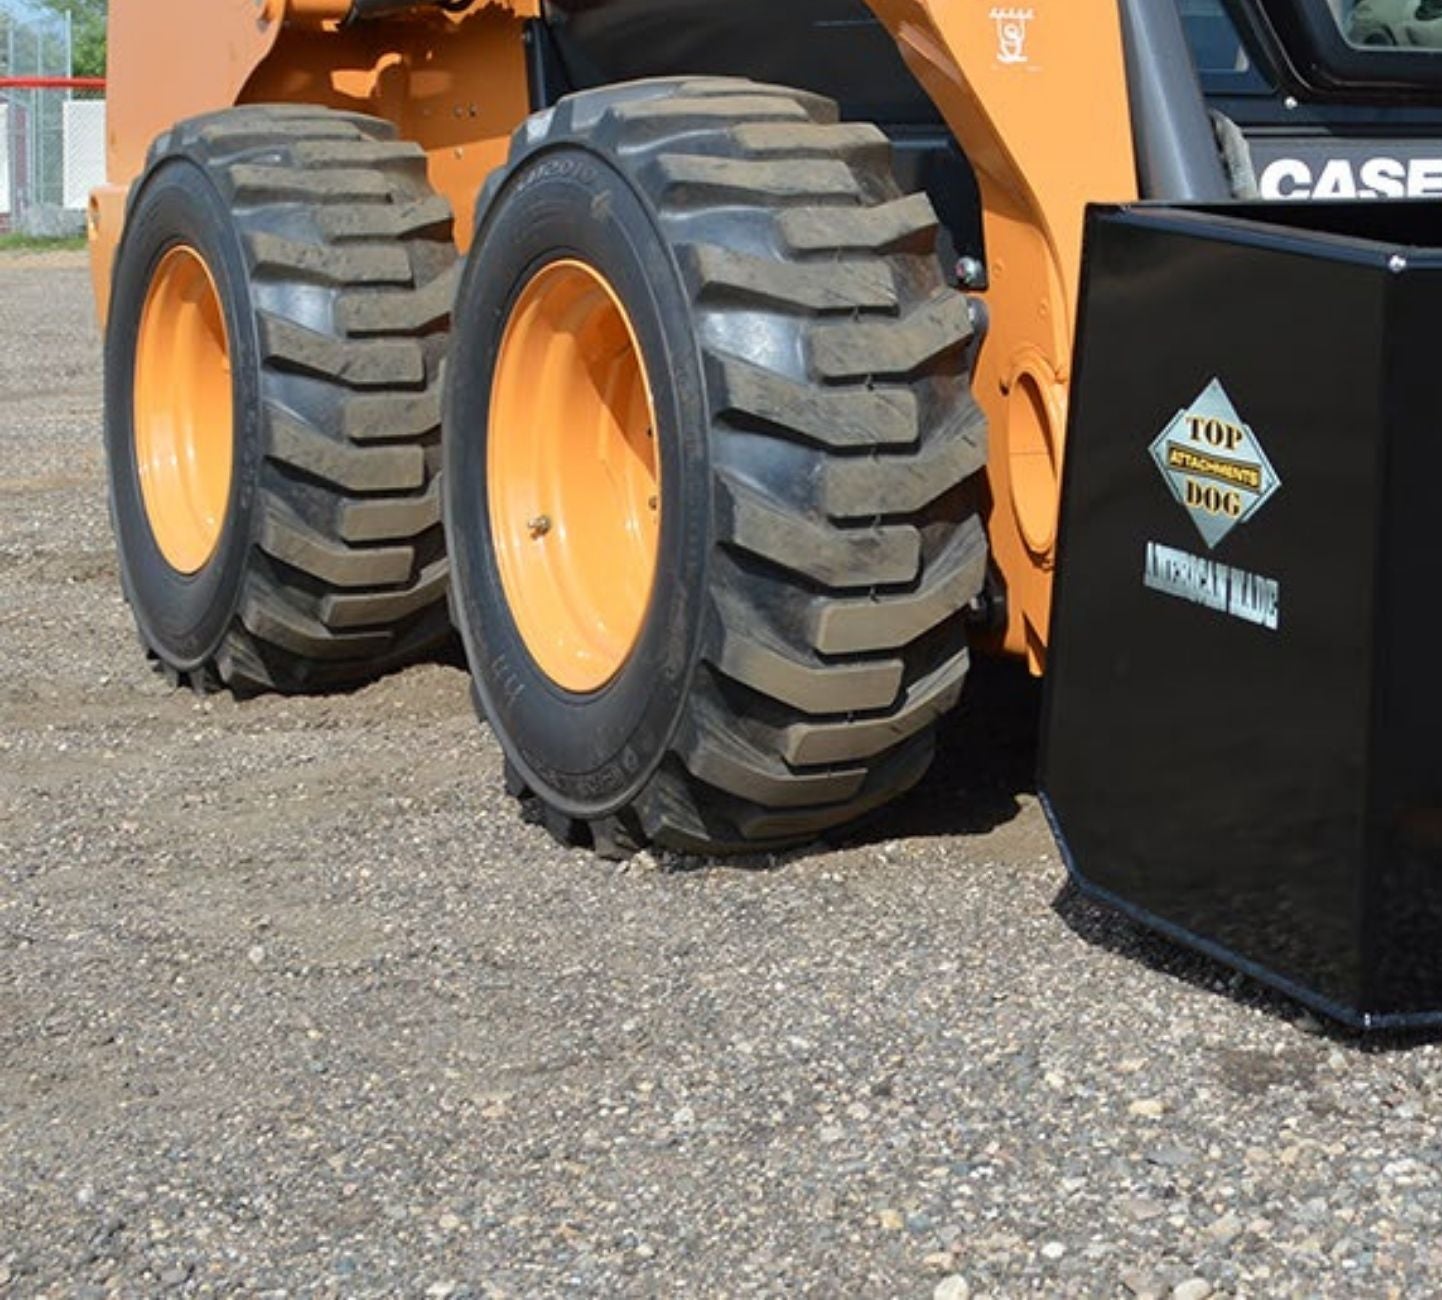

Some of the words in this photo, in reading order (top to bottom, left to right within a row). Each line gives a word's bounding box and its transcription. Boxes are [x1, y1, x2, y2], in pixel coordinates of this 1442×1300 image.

[1186, 415, 1243, 451] TOP
[1170, 449, 1259, 487] ATTACHMENTS
[1185, 478, 1241, 517] DOG
[1143, 540, 1227, 614] AMERICAN
[1229, 566, 1279, 630] MADE
